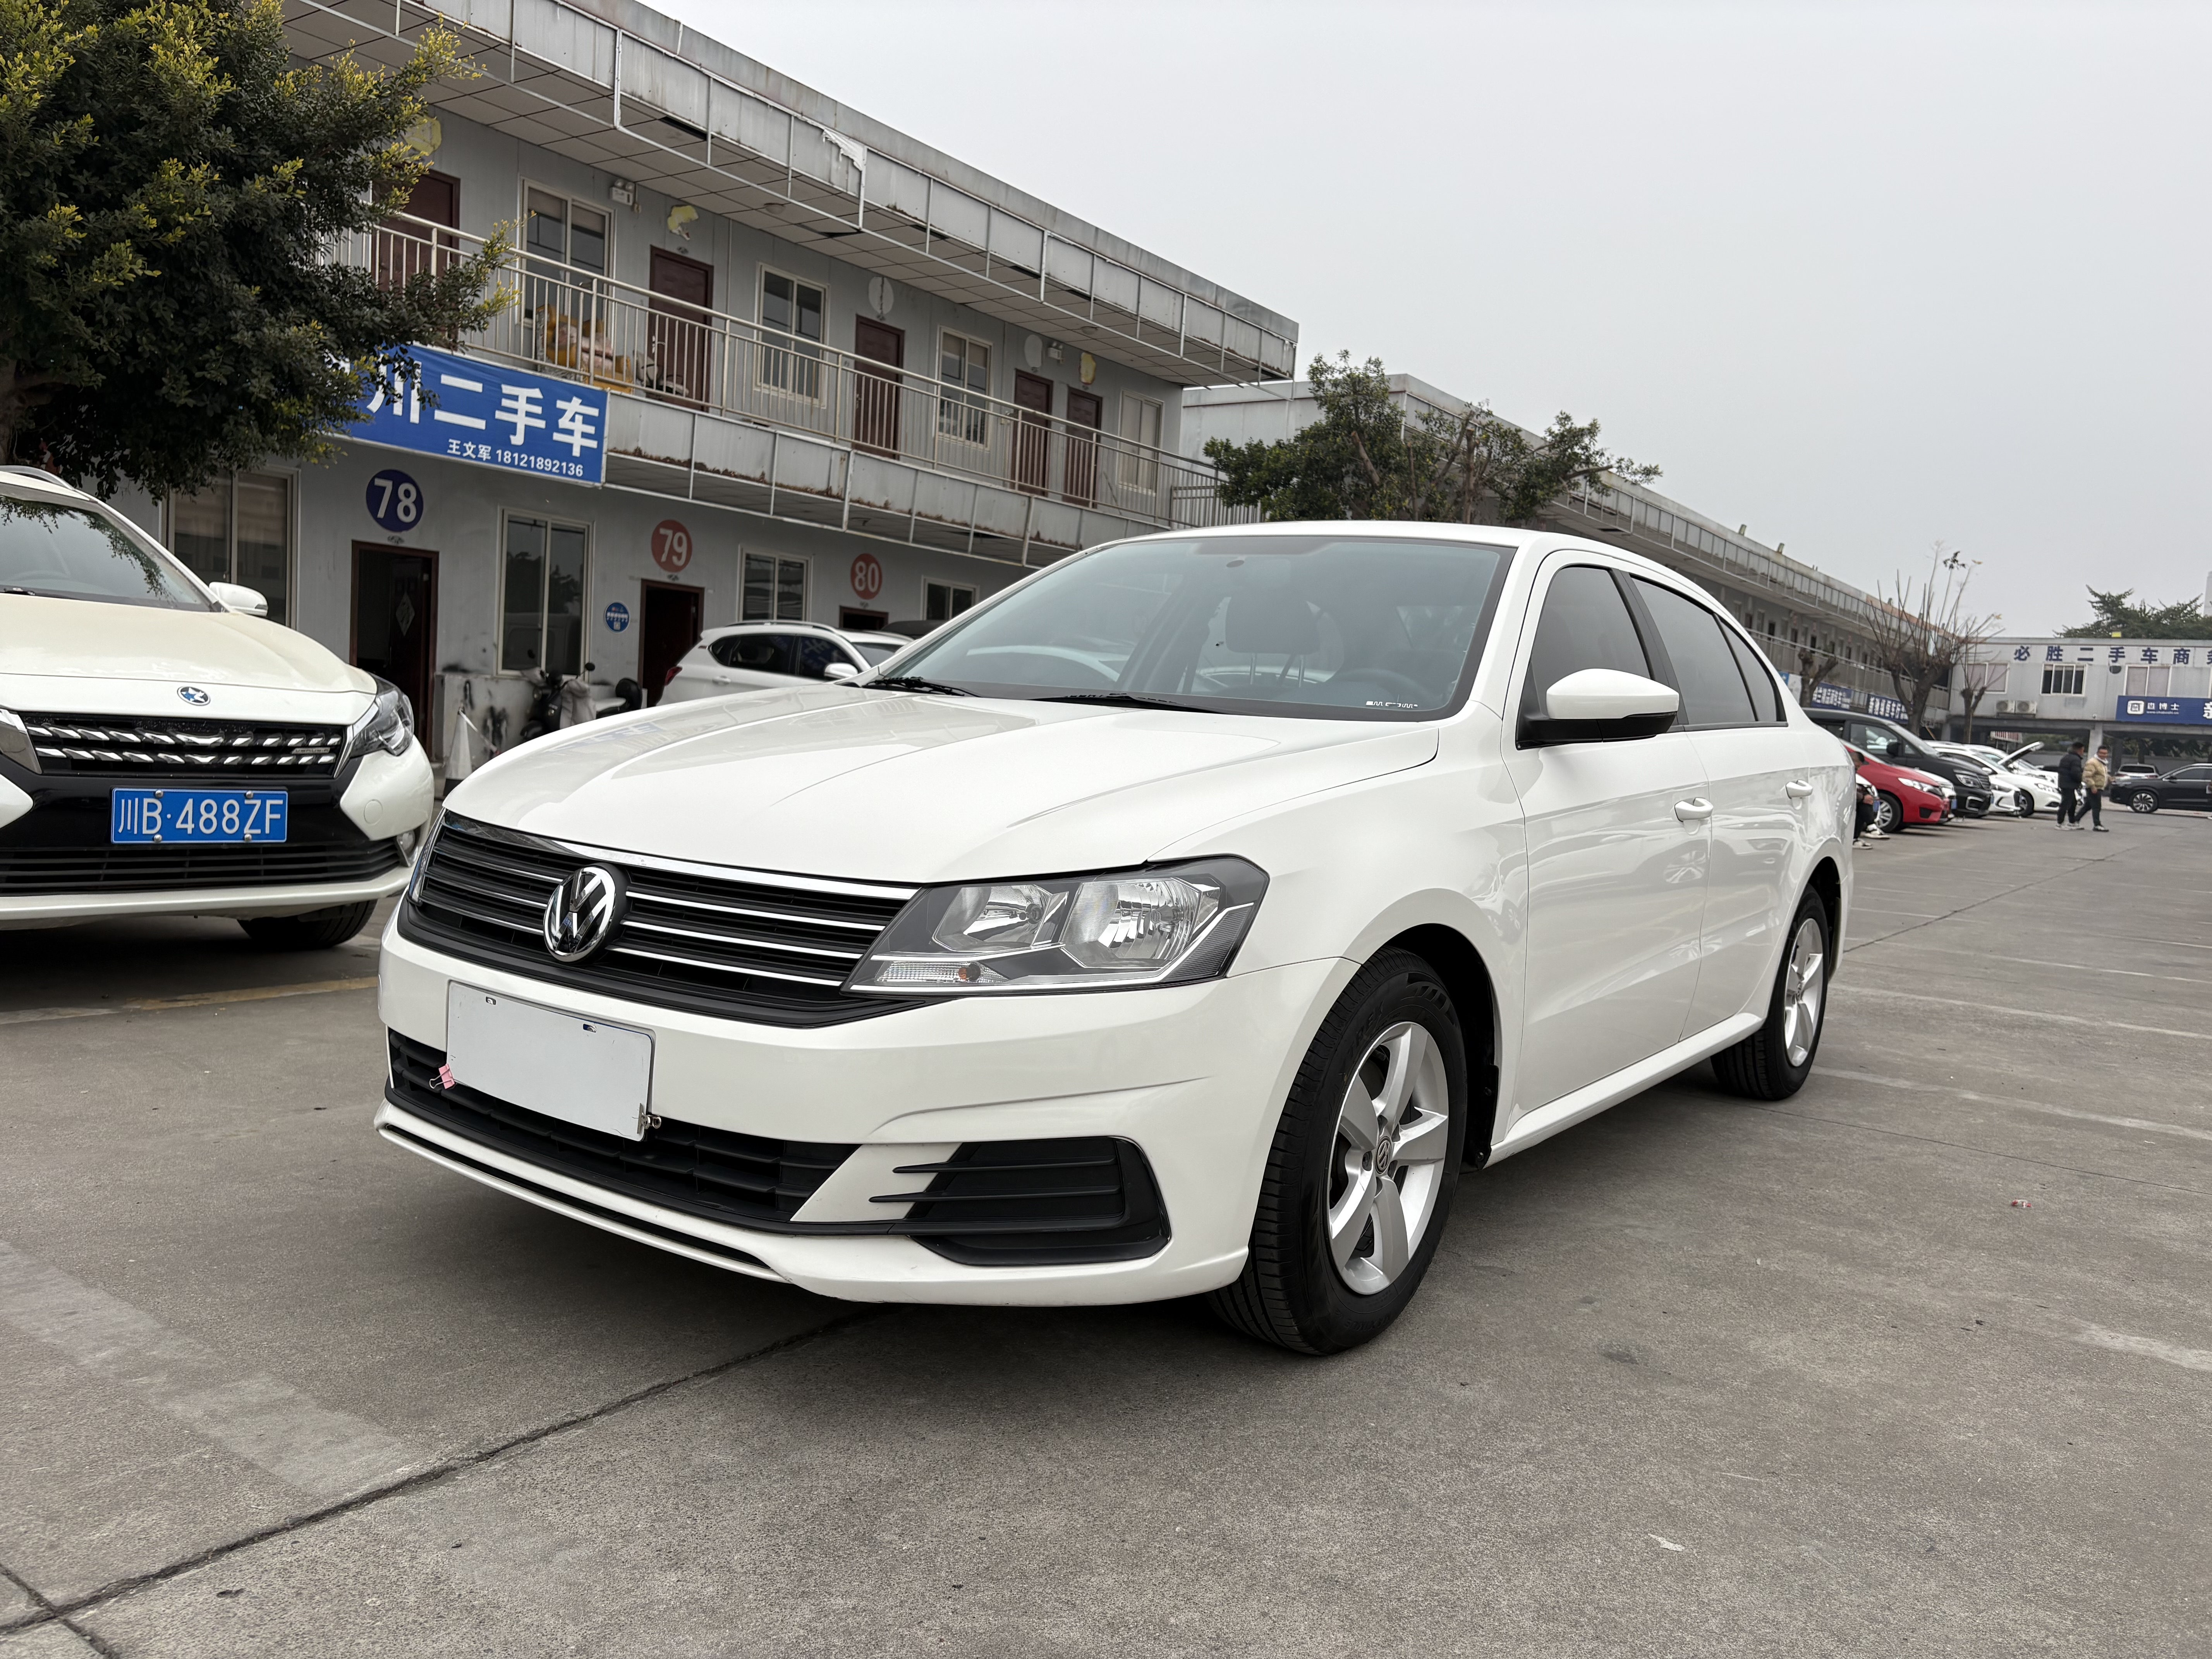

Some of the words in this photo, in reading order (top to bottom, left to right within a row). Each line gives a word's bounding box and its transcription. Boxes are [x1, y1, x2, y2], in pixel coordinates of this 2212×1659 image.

[447, 438, 492, 461] 王文军
[495, 448, 584, 477] 18121892136
[373, 477, 417, 524] 78
[658, 527, 688, 567] 79
[854, 560, 880, 593] 80
[118, 797, 284, 835] 川B·488ZF
